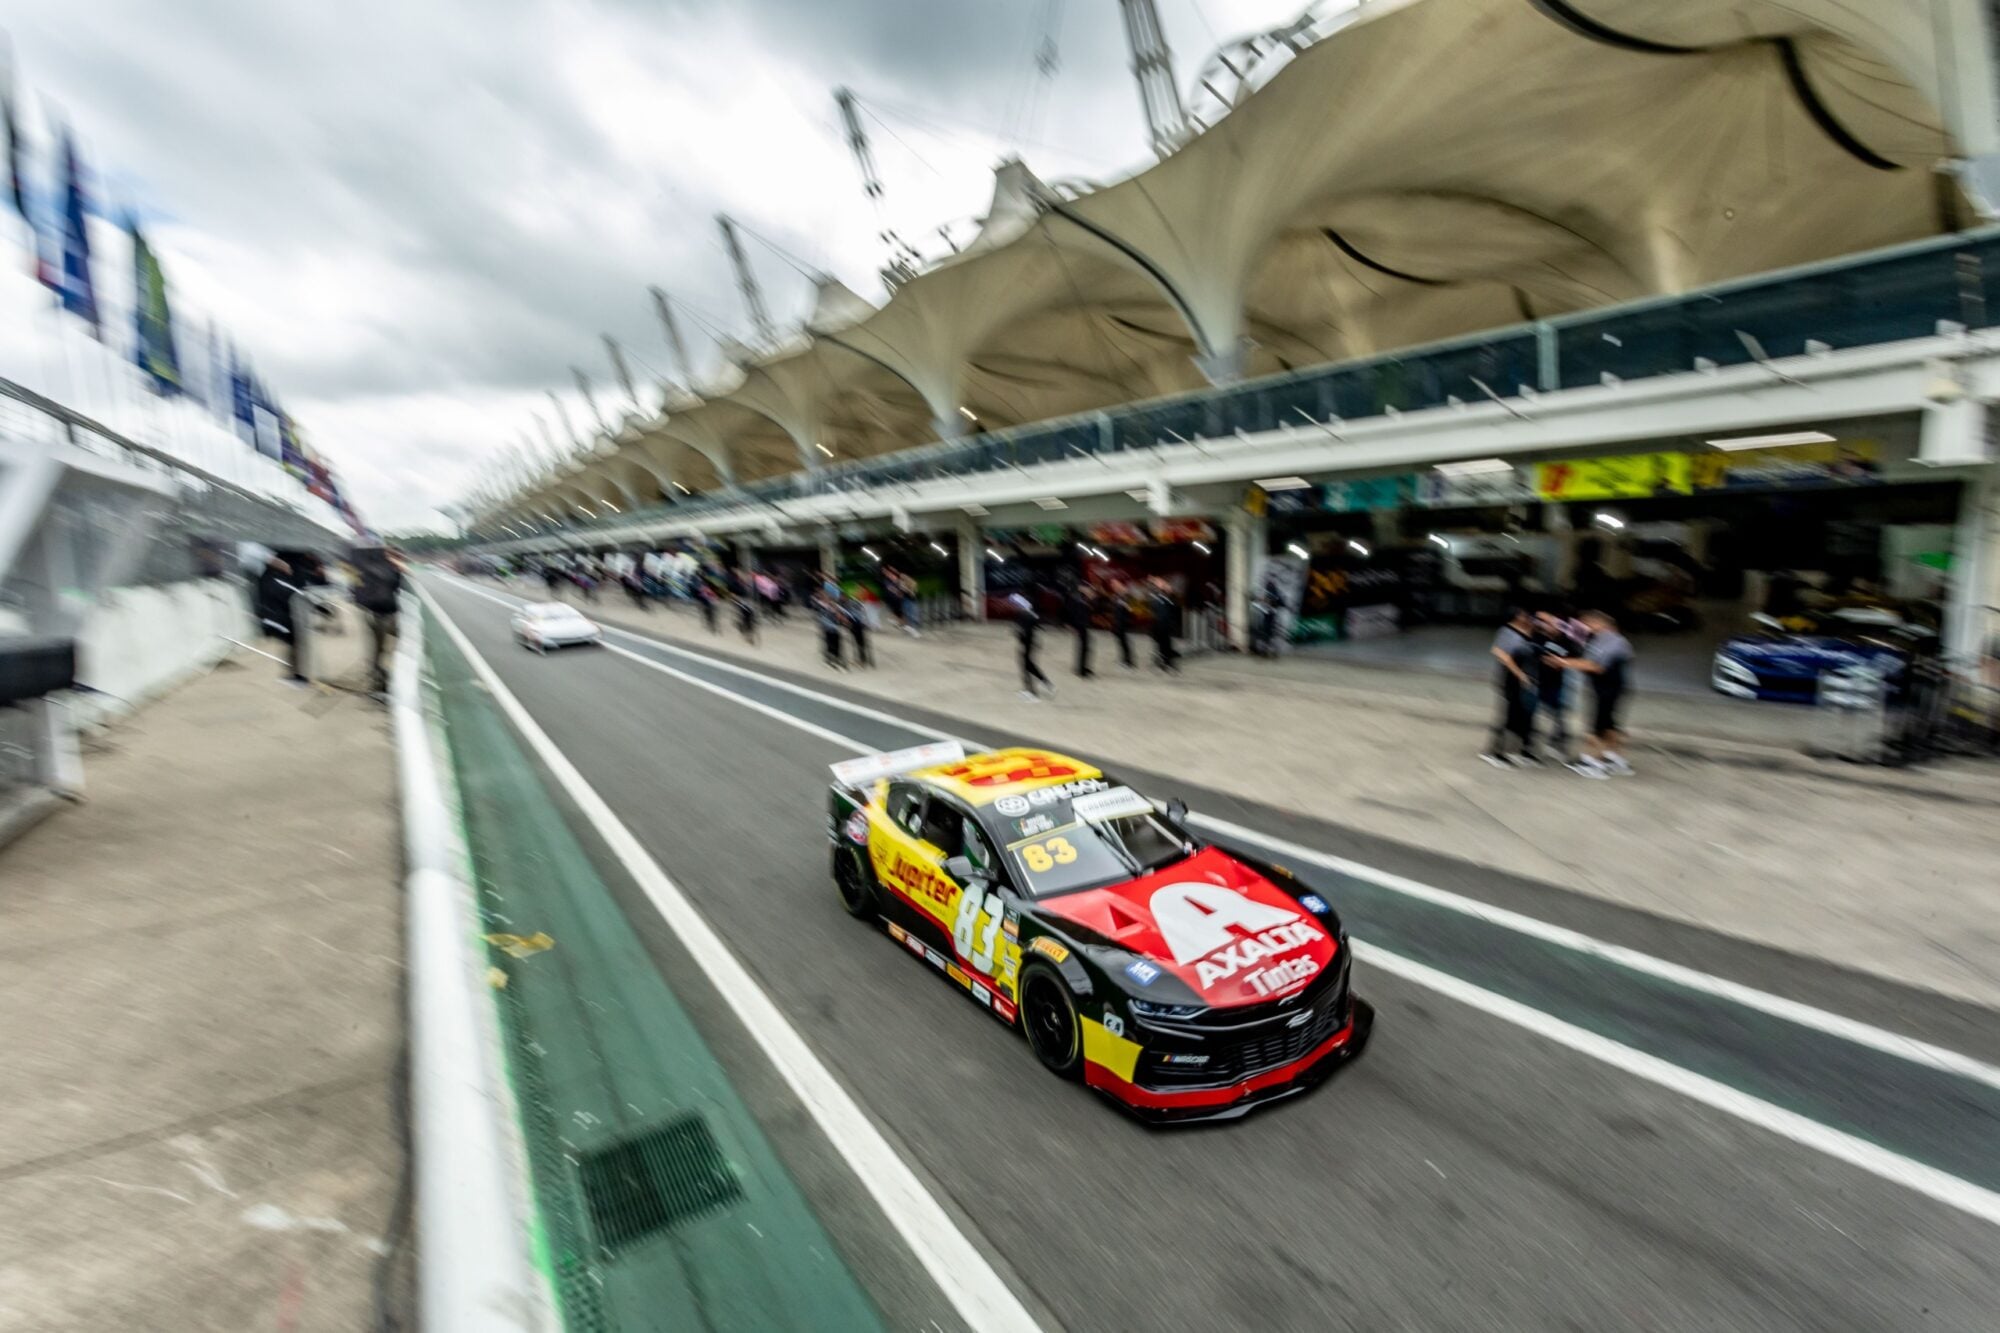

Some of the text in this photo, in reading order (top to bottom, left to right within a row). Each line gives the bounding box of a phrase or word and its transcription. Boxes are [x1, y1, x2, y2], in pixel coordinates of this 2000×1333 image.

[1022, 836, 1078, 872] 83
[953, 881, 1004, 976] 83
[1194, 919, 1325, 990] AXALTA
[1243, 954, 1320, 997] Tintas
